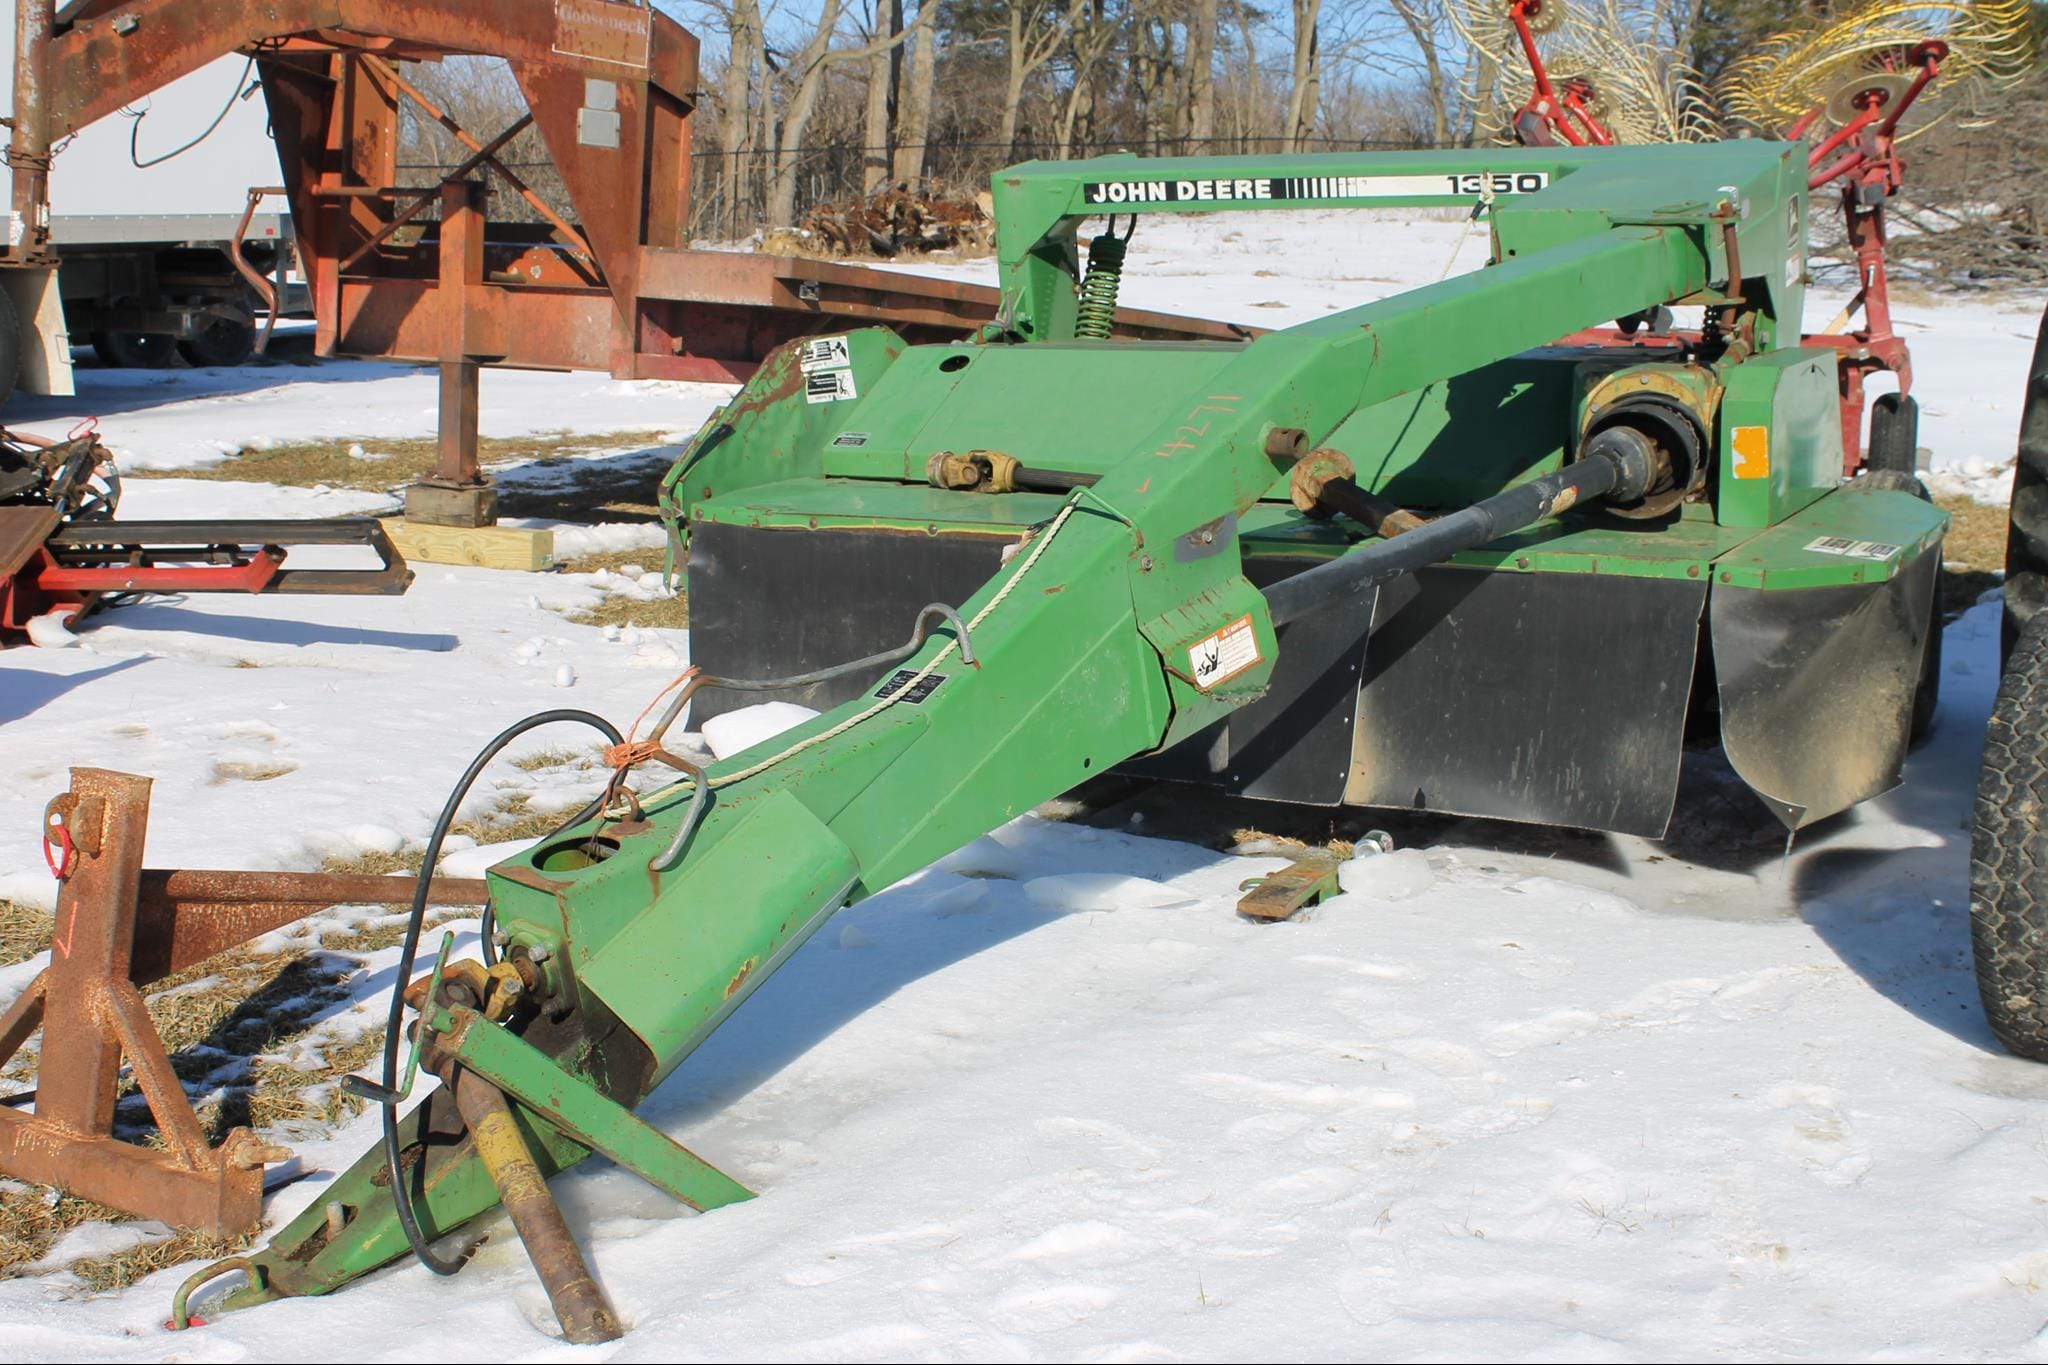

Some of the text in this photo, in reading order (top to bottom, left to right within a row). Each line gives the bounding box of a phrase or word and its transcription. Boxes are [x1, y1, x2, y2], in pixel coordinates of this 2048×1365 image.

[1093, 179, 1271, 203] JOHN DEERE
[1447, 174, 1542, 194] 1350
[1155, 395, 1242, 457] 4271
